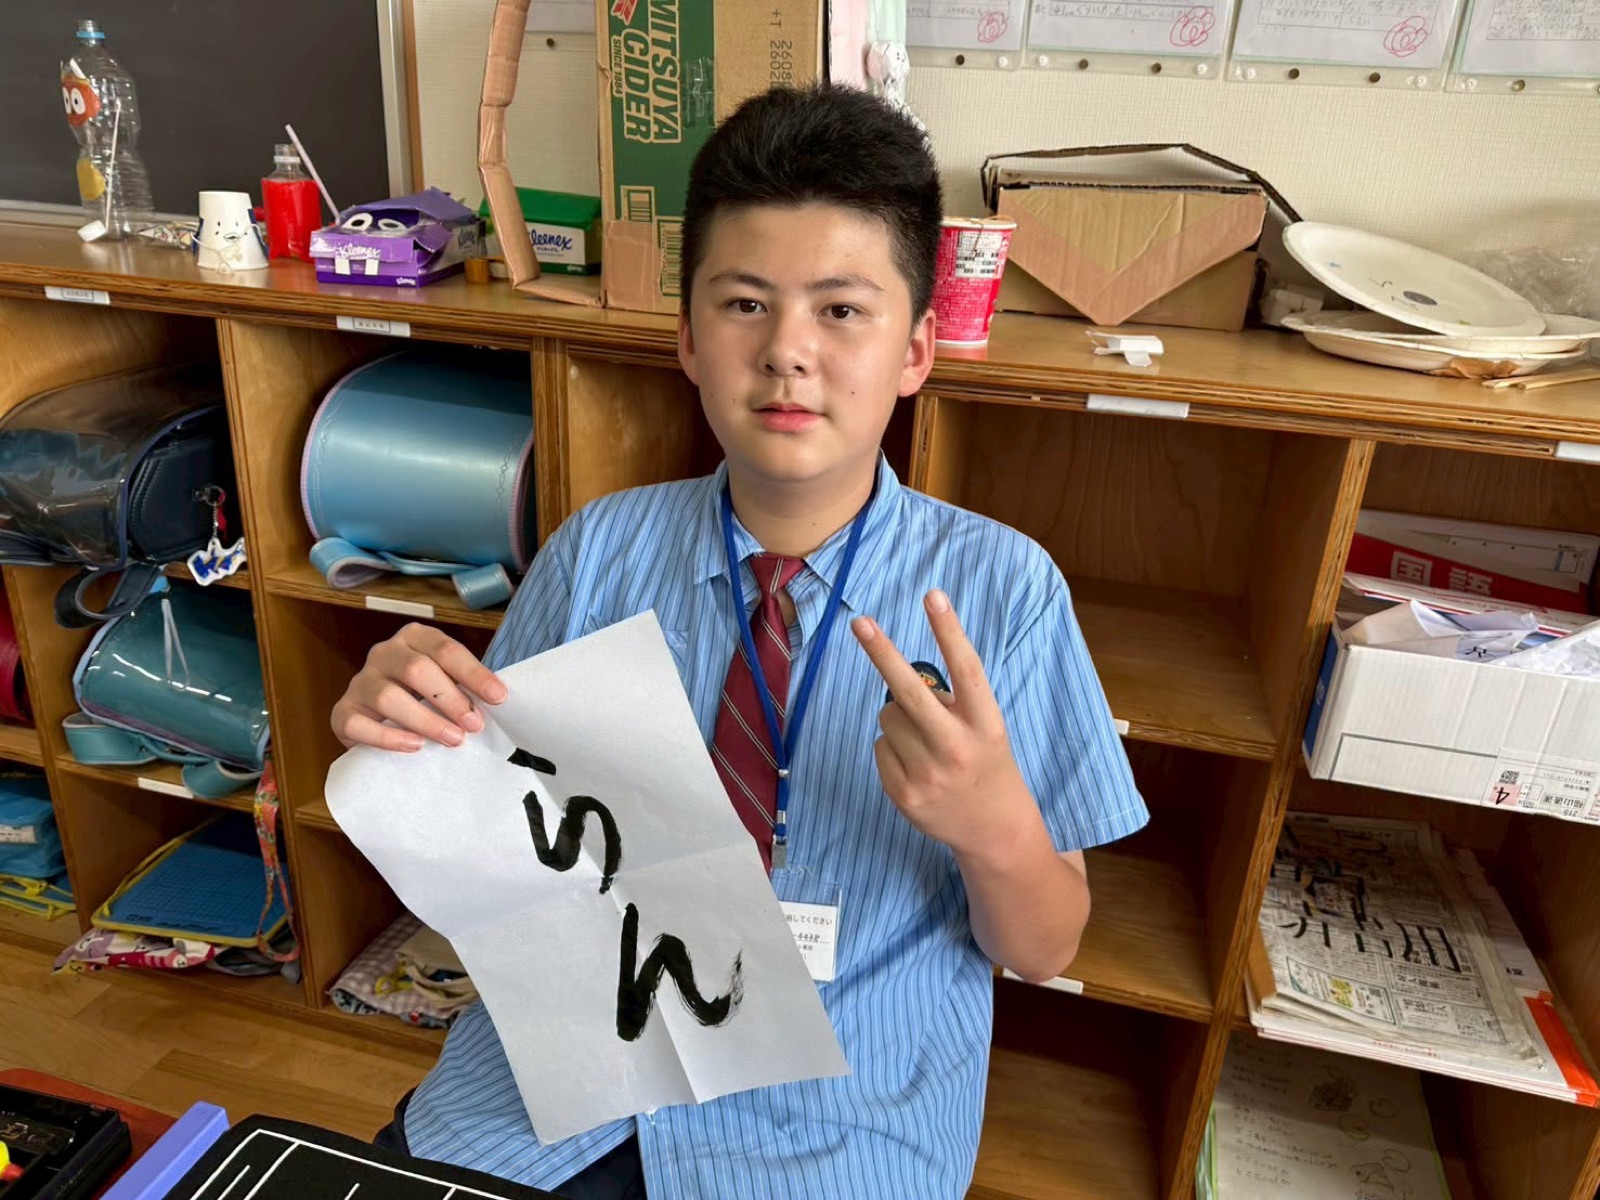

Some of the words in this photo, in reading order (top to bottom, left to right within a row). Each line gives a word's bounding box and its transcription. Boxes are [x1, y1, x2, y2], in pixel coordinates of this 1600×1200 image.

[614, 38, 623, 68] SINCE
[614, 70, 623, 95] 1884
[624, 31, 651, 140] CIDER
[650, 0, 679, 141] MITSUYA
[529, 228, 573, 251] leenex
[1495, 787, 1510, 805] 4
[506, 747, 745, 1042] らん
